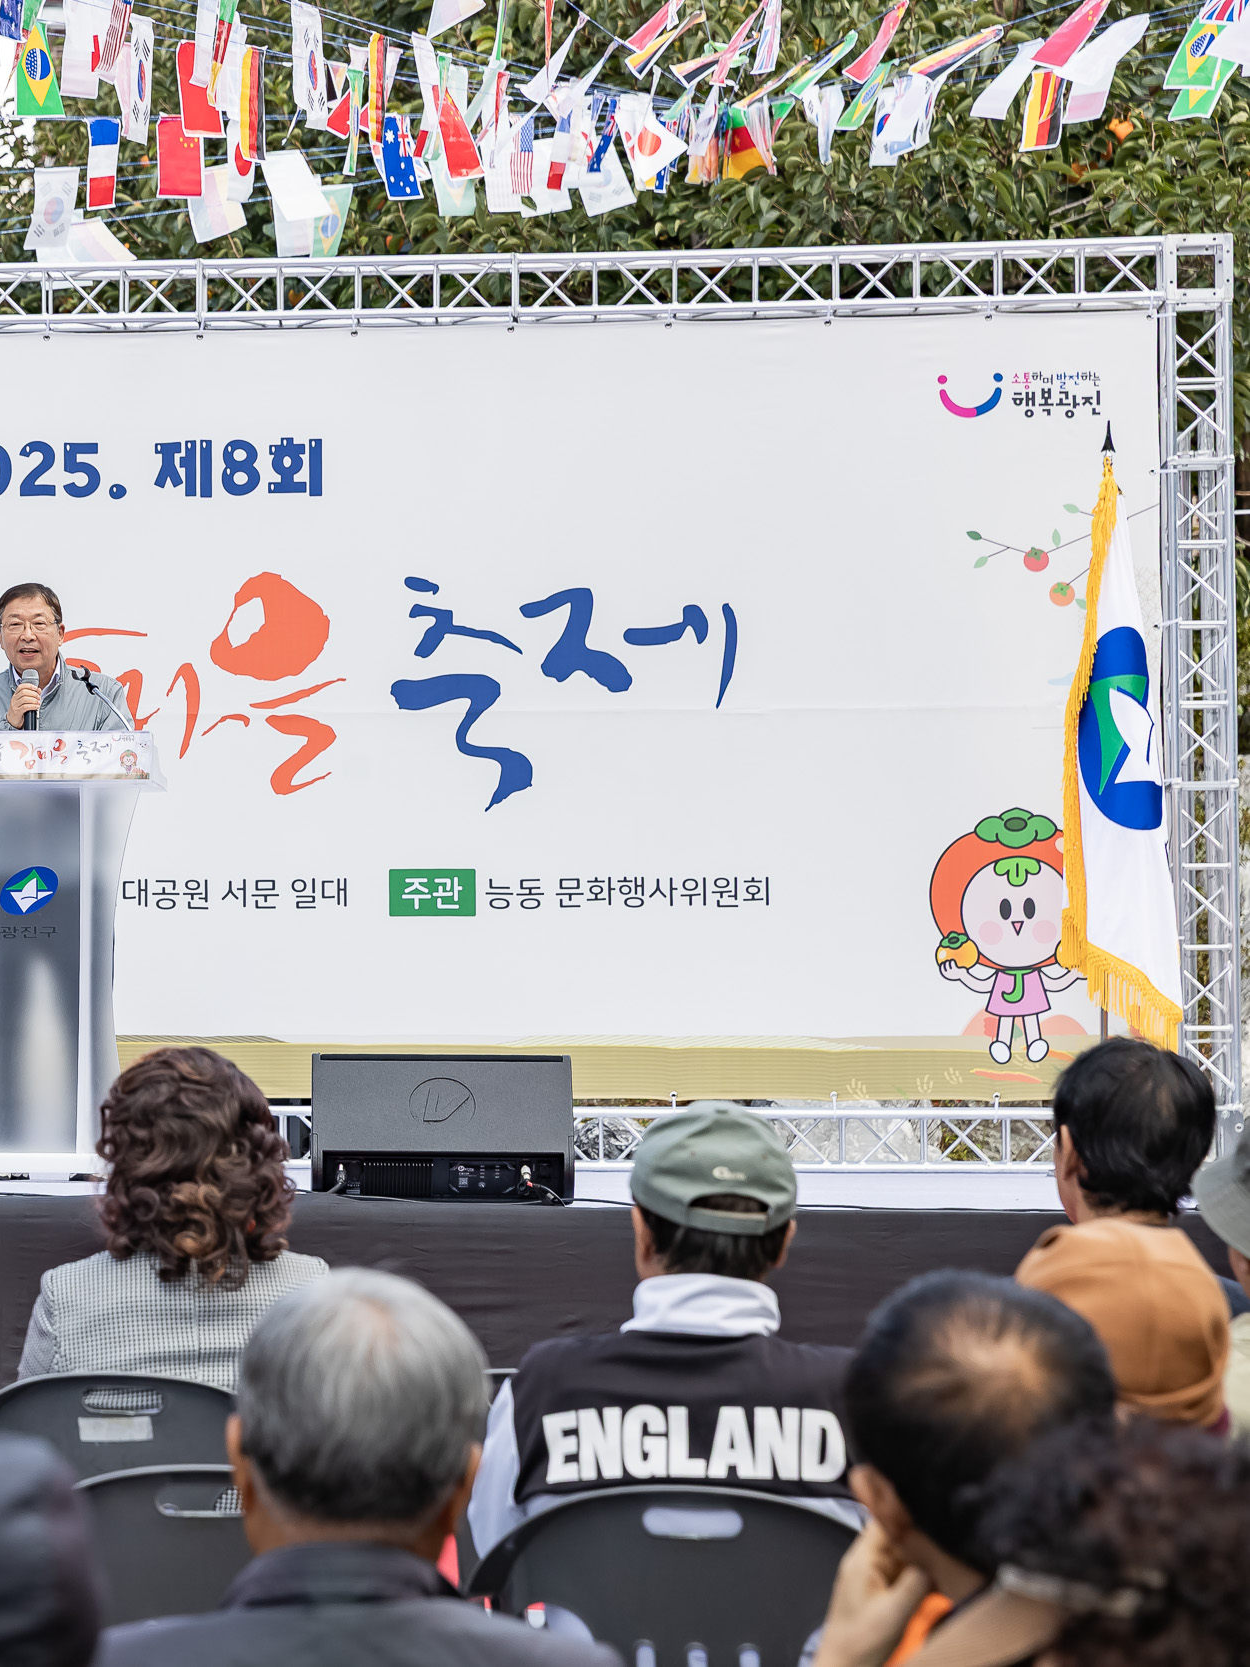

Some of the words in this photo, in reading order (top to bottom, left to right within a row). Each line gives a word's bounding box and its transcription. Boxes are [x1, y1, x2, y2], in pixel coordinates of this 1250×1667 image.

[1011, 371, 1054, 389] 소통하며
[1056, 371, 1100, 389] 발전하는
[1011, 387, 1101, 418] 행복광진
[154, 437, 323, 498] 제8회
[390, 576, 739, 812] 축제
[220, 878, 281, 910] 서문
[290, 877, 349, 910] 일대
[401, 876, 464, 911] 주관
[484, 878, 545, 910] 능동
[555, 875, 770, 909] 문화행사위원회
[0, 924, 59, 940] 광진구
[542, 1403, 847, 1484] ENGLAND
